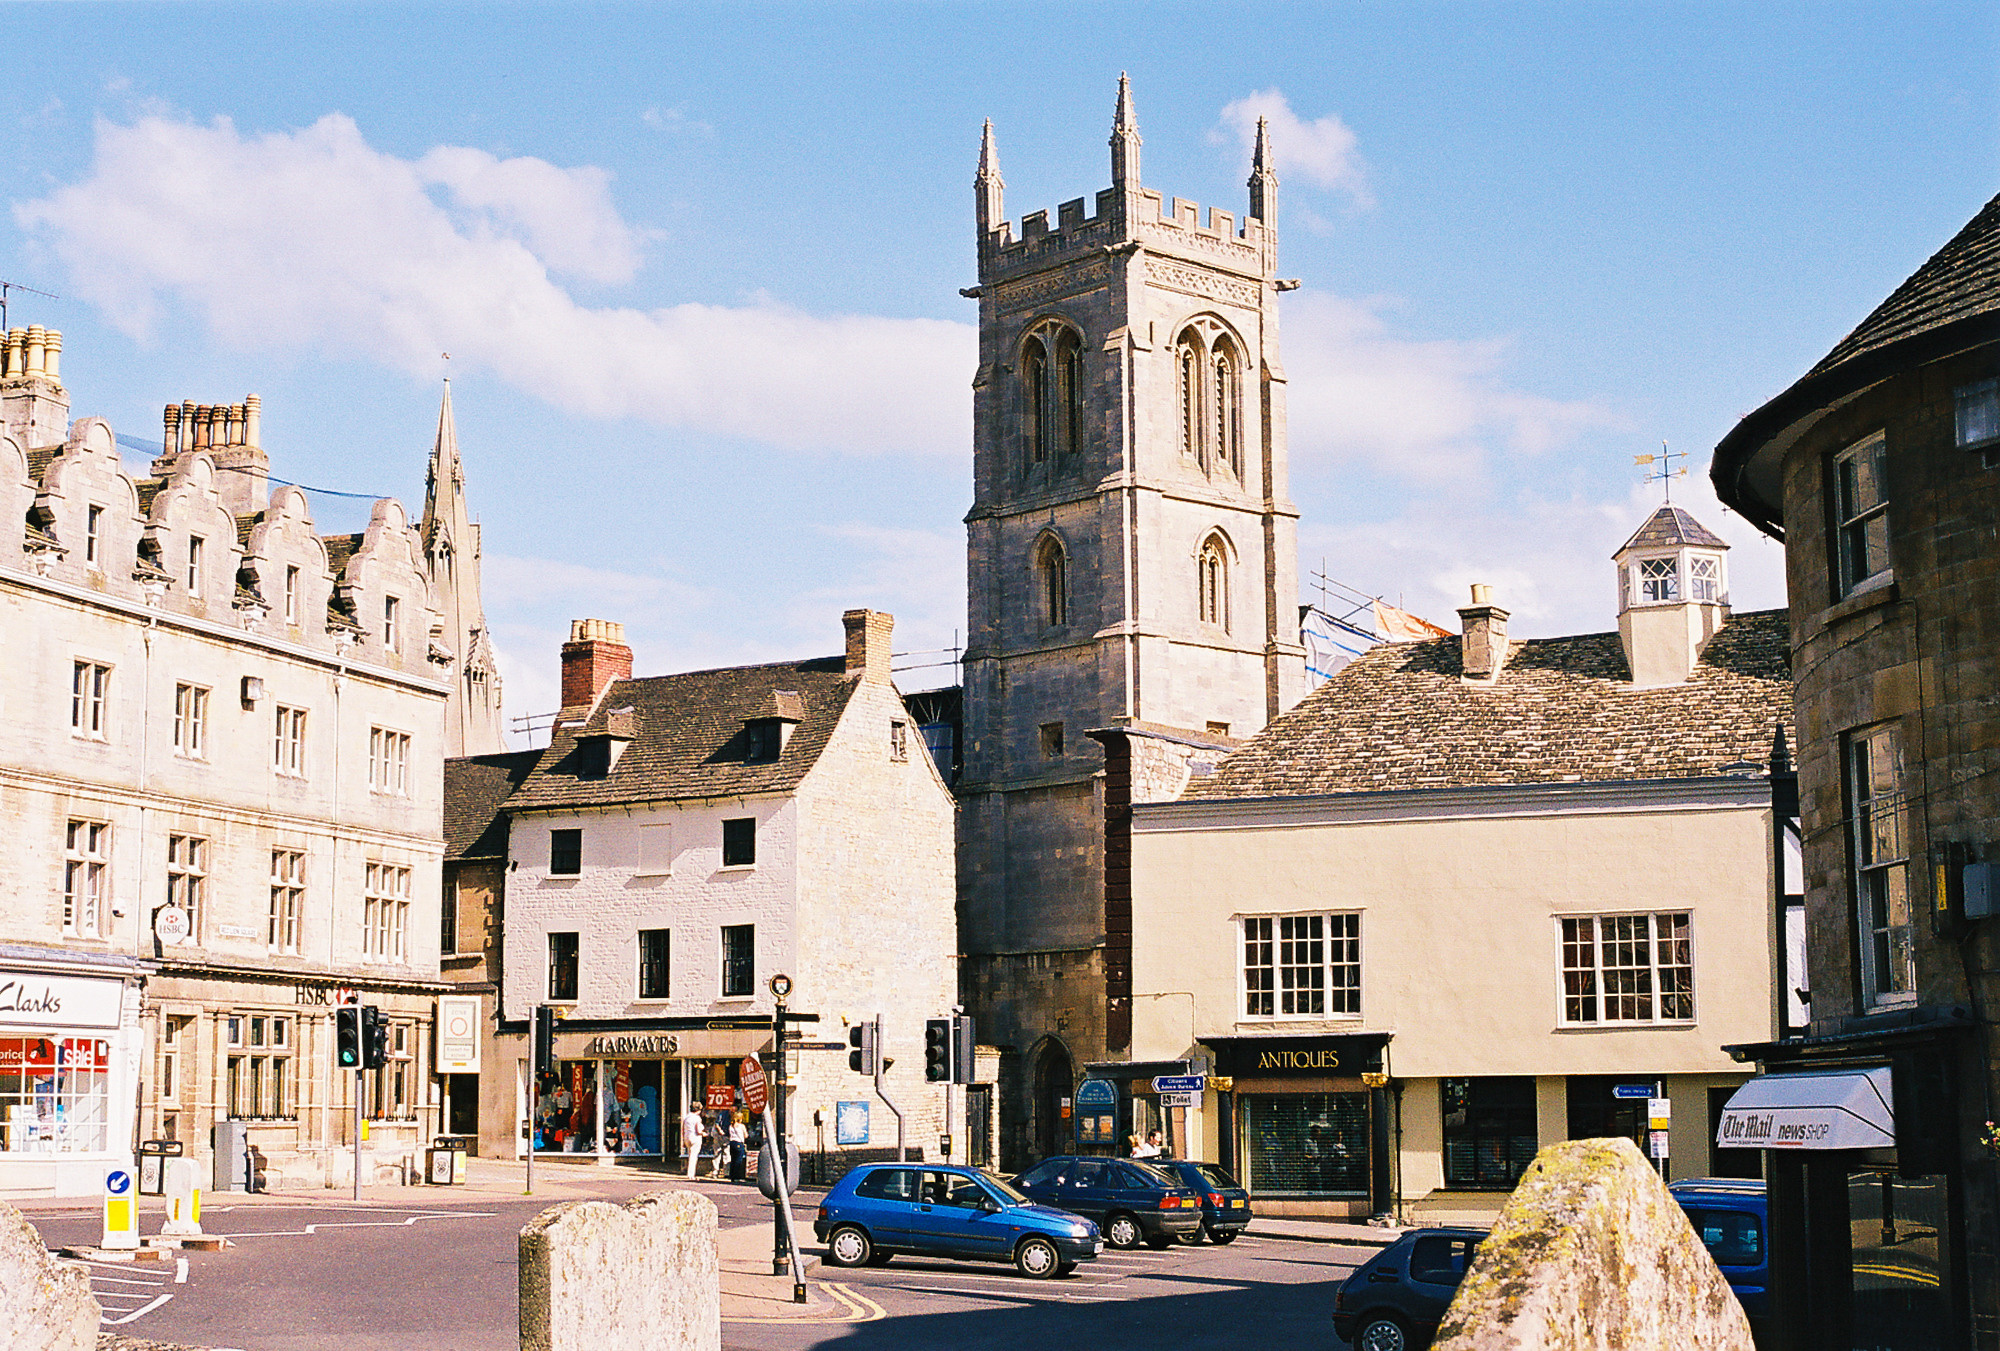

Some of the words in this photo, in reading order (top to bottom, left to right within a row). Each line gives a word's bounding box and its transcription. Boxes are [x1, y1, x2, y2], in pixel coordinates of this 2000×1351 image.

[159, 924, 185, 934] HSBC
[295, 983, 334, 1006] HSBC
[1258, 1050, 1339, 1068] ANTIQUES
[708, 1093, 729, 1105] 70%
[1724, 1114, 1745, 1139] The
[1745, 1114, 1774, 1139] Mail
